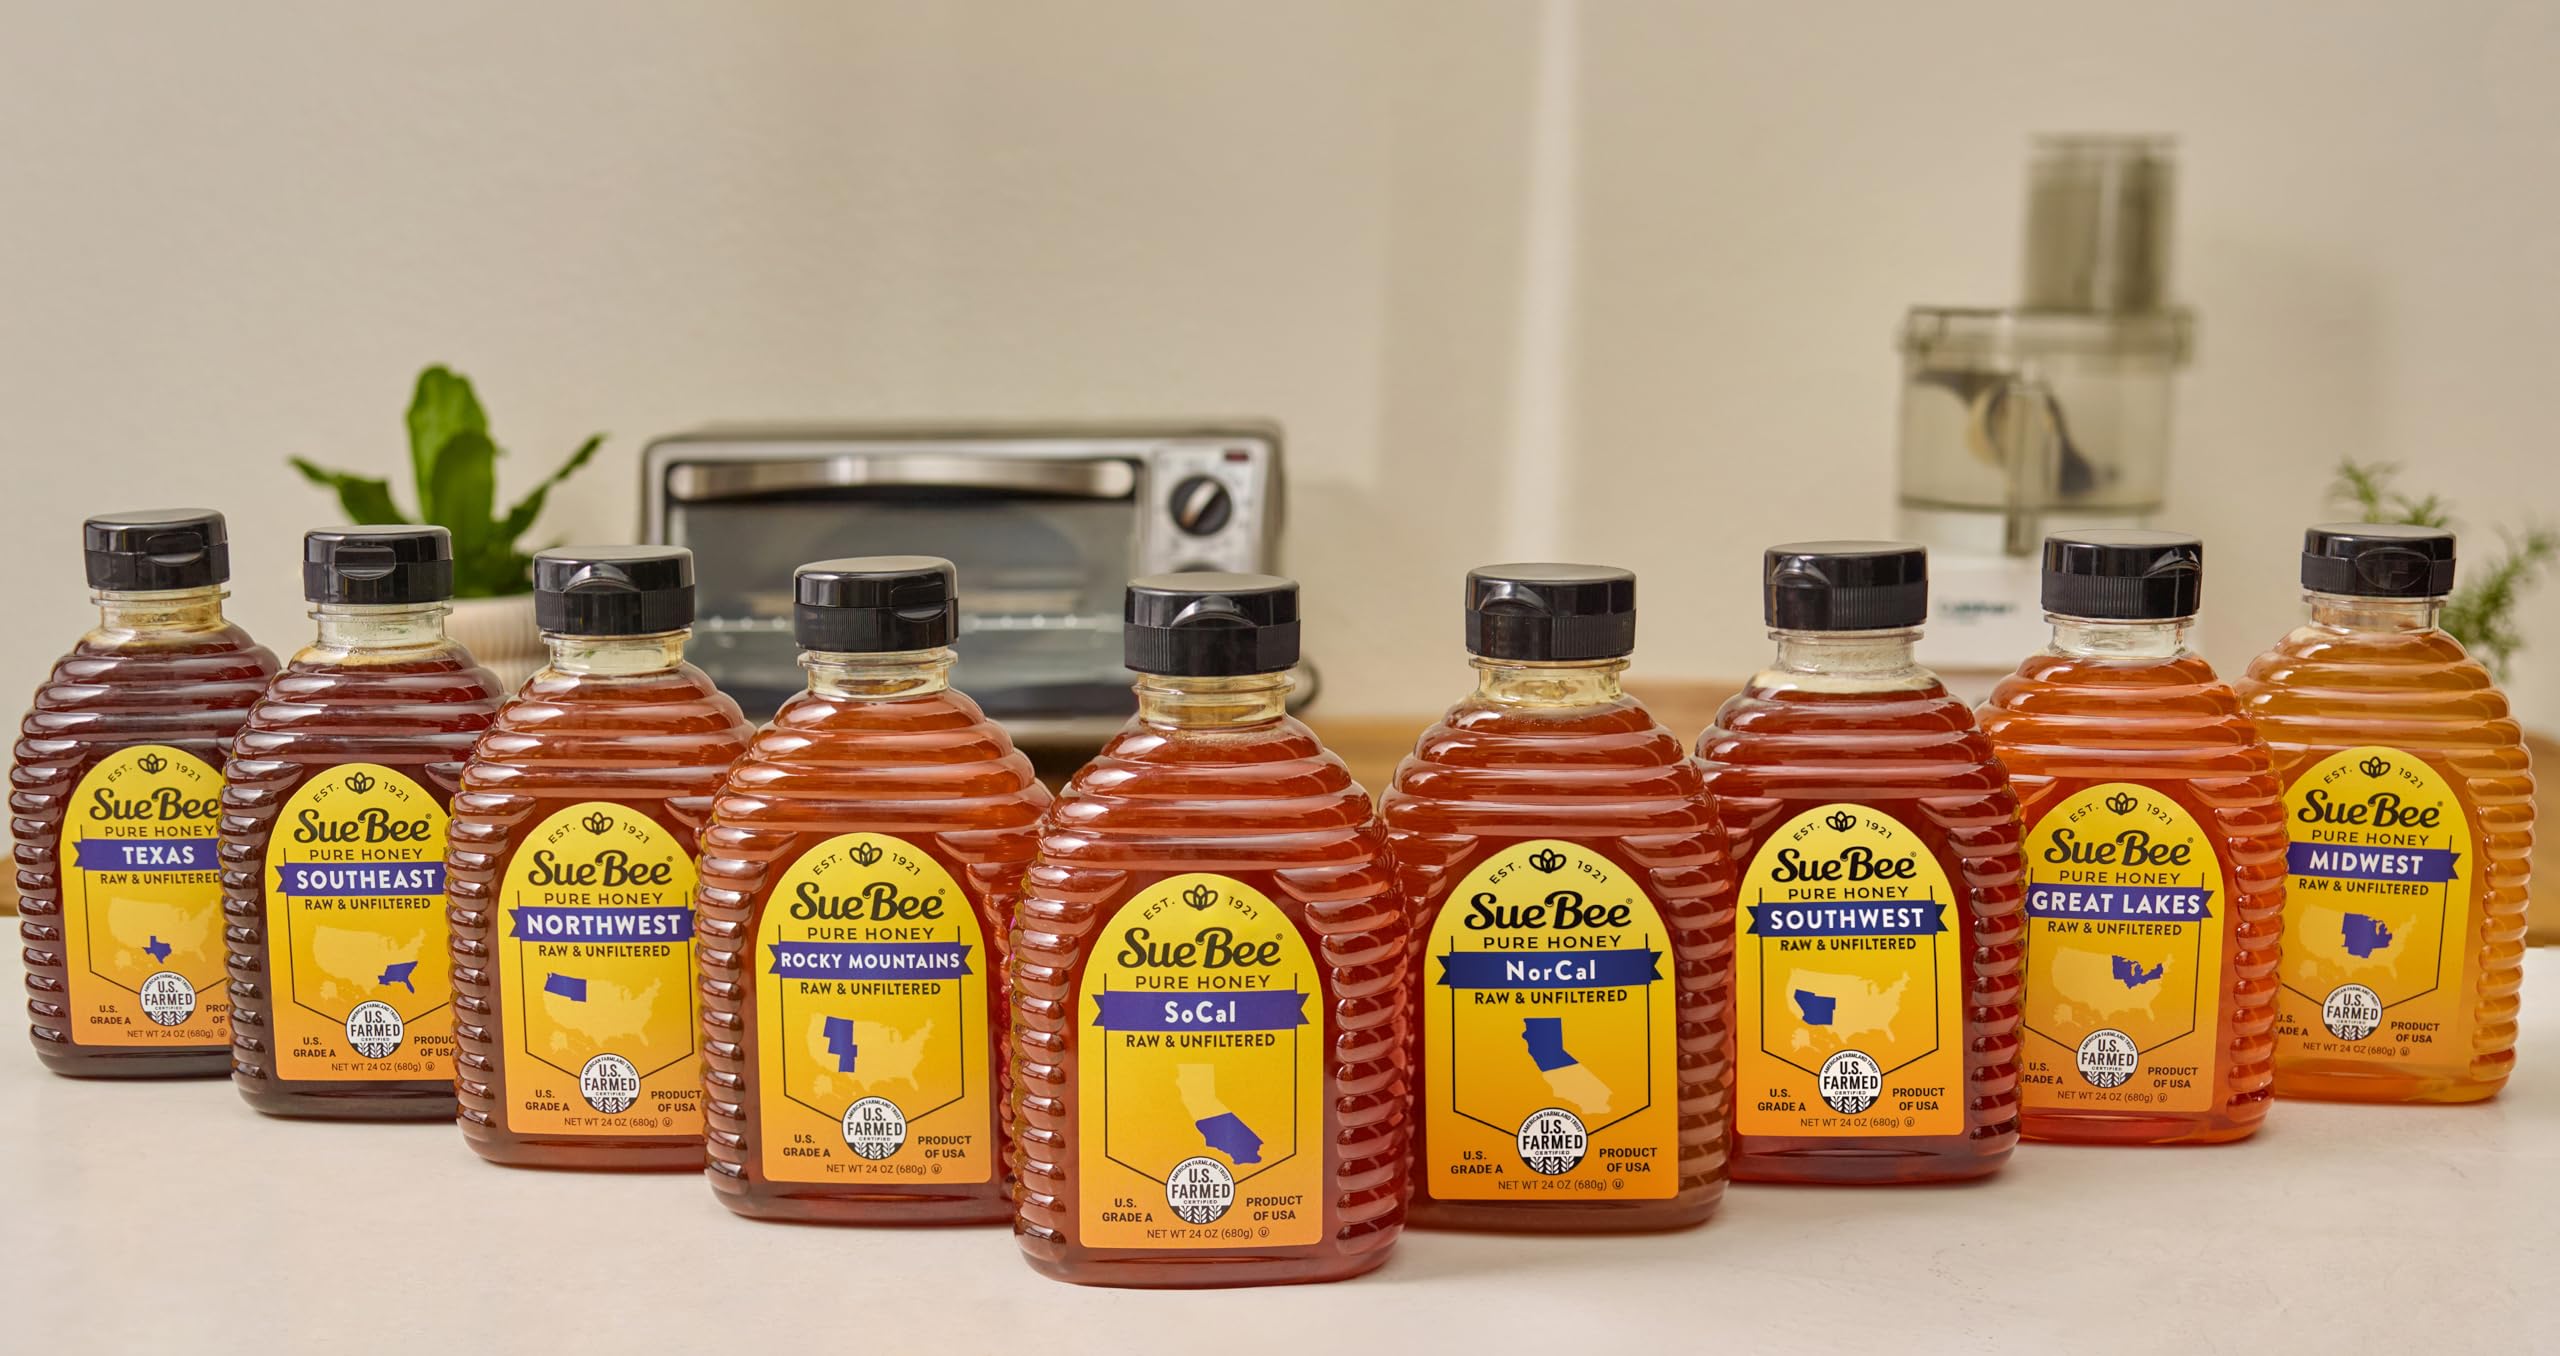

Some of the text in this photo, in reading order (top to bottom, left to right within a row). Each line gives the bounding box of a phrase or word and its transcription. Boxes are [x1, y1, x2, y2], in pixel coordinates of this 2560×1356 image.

[107, 762, 202, 783] EST. 1921
[2323, 766, 2424, 789] EST. 1921
[313, 781, 410, 803] EST. 1921
[2069, 803, 2173, 826] EST. 1921
[104, 825, 215, 838] PURE HONEY
[547, 821, 650, 844] EST. 1921
[1792, 819, 1893, 842] EST. 1921
[2311, 829, 2429, 846] PURE HONEY
[123, 846, 195, 865] TEXAS
[310, 848, 423, 861] PURE HONEY
[812, 853, 921, 876] EST. 1921
[2309, 850, 2424, 875] MIDWEST
[100, 873, 220, 885] RAW & UNFILTERED
[296, 868, 436, 890] SOUTHEAST
[1489, 860, 1608, 885] EST. 1921
[2059, 870, 2181, 885] PURE HONEY
[1789, 886, 1909, 900] PURE HONEY
[2298, 878, 2429, 896] RAW & UNFILTERED
[305, 898, 431, 910] RAW & UNFILTERED
[544, 892, 664, 905] PURE HONEY
[2031, 890, 2201, 915] GREAT LAKES
[1143, 896, 1259, 921] EST. 1921
[527, 914, 681, 936] NORTHWEST
[1770, 908, 1924, 930] SOUTHWEST
[808, 927, 935, 940] PURE HONEY
[2047, 920, 2182, 936] RAW & UNFILTERED
[1483, 935, 1622, 949] PURE HONEY
[1780, 937, 1917, 951] RAW & UNFILTERED
[539, 944, 671, 957] RAW & UNFILTERED
[781, 952, 960, 969] ROCKY MOUNTAINS
[1506, 959, 1596, 981] NorCal
[157, 981, 178, 993] U.S.
[800, 982, 941, 995] RAW & UNFILTERED
[1136, 975, 1271, 989] PURE HONEY
[145, 992, 193, 1006] FARMED
[1474, 989, 1628, 1005] RAW & UNFILTERED
[2343, 993, 2365, 1007] U.S.
[364, 1010, 386, 1024] U.S.
[1164, 1000, 1236, 1024] SoCal
[2326, 1006, 2378, 1021] FARMED
[350, 1023, 400, 1037] FARMED
[1126, 1033, 1276, 1048] RAW & UNFILTERED
[2097, 1039, 2120, 1052] U.S.
[2081, 1051, 2135, 1067] FARMED
[599, 1064, 621, 1078] U.S.
[1839, 1061, 1863, 1075] U.S.
[584, 1077, 636, 1091] FARMED
[1823, 1075, 1879, 1090] FARMED
[535, 1089, 556, 1099] U.S.
[651, 1090, 702, 1099] PRODUCT
[1769, 1089, 1791, 1098] U.S.
[1892, 1087, 1945, 1097] PRODUCT
[525, 1102, 570, 1112] GRADE A
[658, 1103, 696, 1113] OF USA
[1757, 1102, 1806, 1112] GRADE A
[1899, 1101, 1939, 1111] OF USA
[863, 1107, 887, 1122] U.S.
[847, 1122, 903, 1137] FARMED
[1540, 1119, 1566, 1135] U.S.
[794, 1134, 816, 1144] U.S.
[917, 1135, 972, 1145] PRODUCT
[1522, 1134, 1583, 1150] FARMED
[783, 1147, 831, 1158] GRADE A
[924, 1149, 966, 1159] OF USA
[1463, 1151, 1487, 1160] U.S.
[1599, 1147, 1658, 1158] PRODUCT
[826, 1164, 927, 1175] NET WT 24 OZ (680g)
[1450, 1163, 1504, 1175] GRADE A
[1606, 1162, 1651, 1173] OF USA
[1188, 1168, 1214, 1184] U.S.
[1171, 1184, 1231, 1199] FARMED
[1498, 1179, 1607, 1191] NET WT 24 OZ (680g)
[1114, 1198, 1137, 1208] U.S.
[1246, 1195, 1303, 1207] PRODUCT
[1102, 1212, 1153, 1223] GRADE A
[1253, 1210, 1297, 1221] OF USA
[1147, 1228, 1254, 1240] NET WT 24 OZ (680g)
